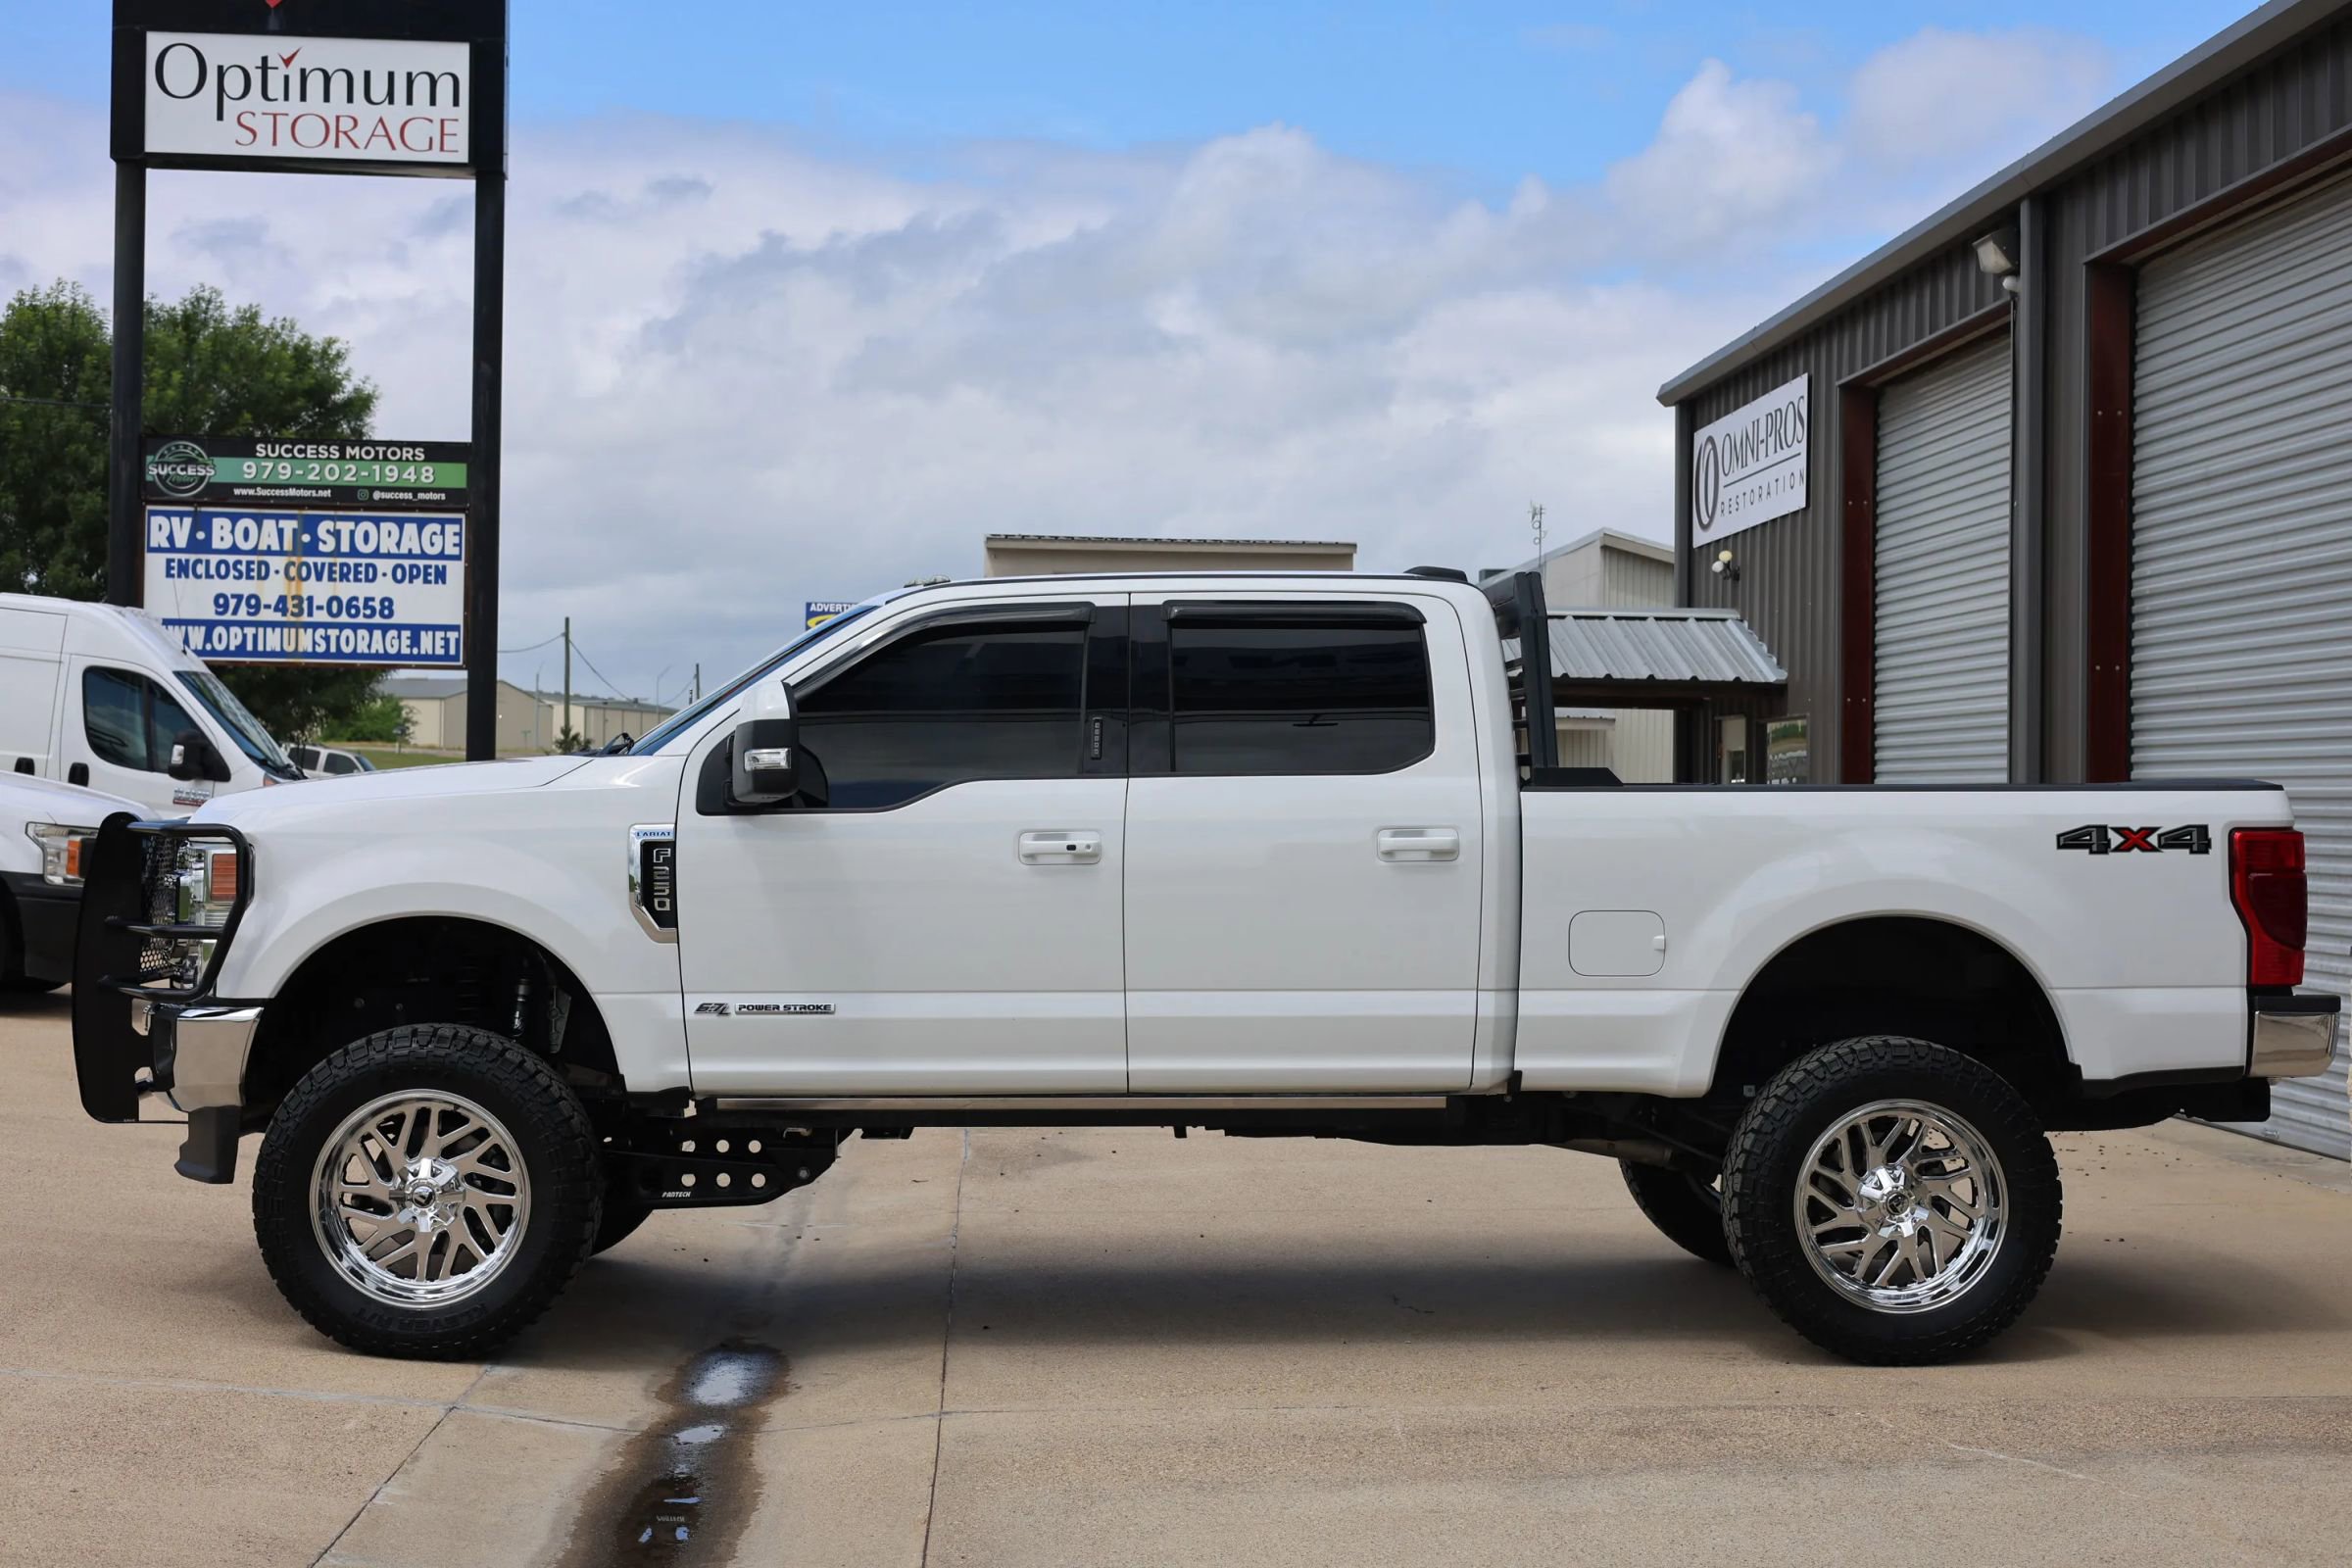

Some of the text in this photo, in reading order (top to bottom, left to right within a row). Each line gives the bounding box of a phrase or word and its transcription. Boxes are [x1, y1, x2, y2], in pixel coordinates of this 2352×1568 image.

[154, 42, 461, 121] Optimum
[234, 111, 460, 153] STORAGE
[1721, 395, 1805, 476] OMNI-PROS
[255, 443, 425, 462] SUCCESS MOTORS
[148, 464, 215, 476] SUCCESS
[242, 461, 436, 484] 979-202-1948
[233, 487, 332, 498] www.SuccessMotors.net
[372, 491, 446, 501] @success_motors
[1720, 467, 1805, 516] RESTORATION
[149, 515, 461, 556] RV BOAT STORAGE
[165, 558, 448, 585] ENCLOSED COVERED OPEN
[213, 593, 395, 619] 979-431-0658
